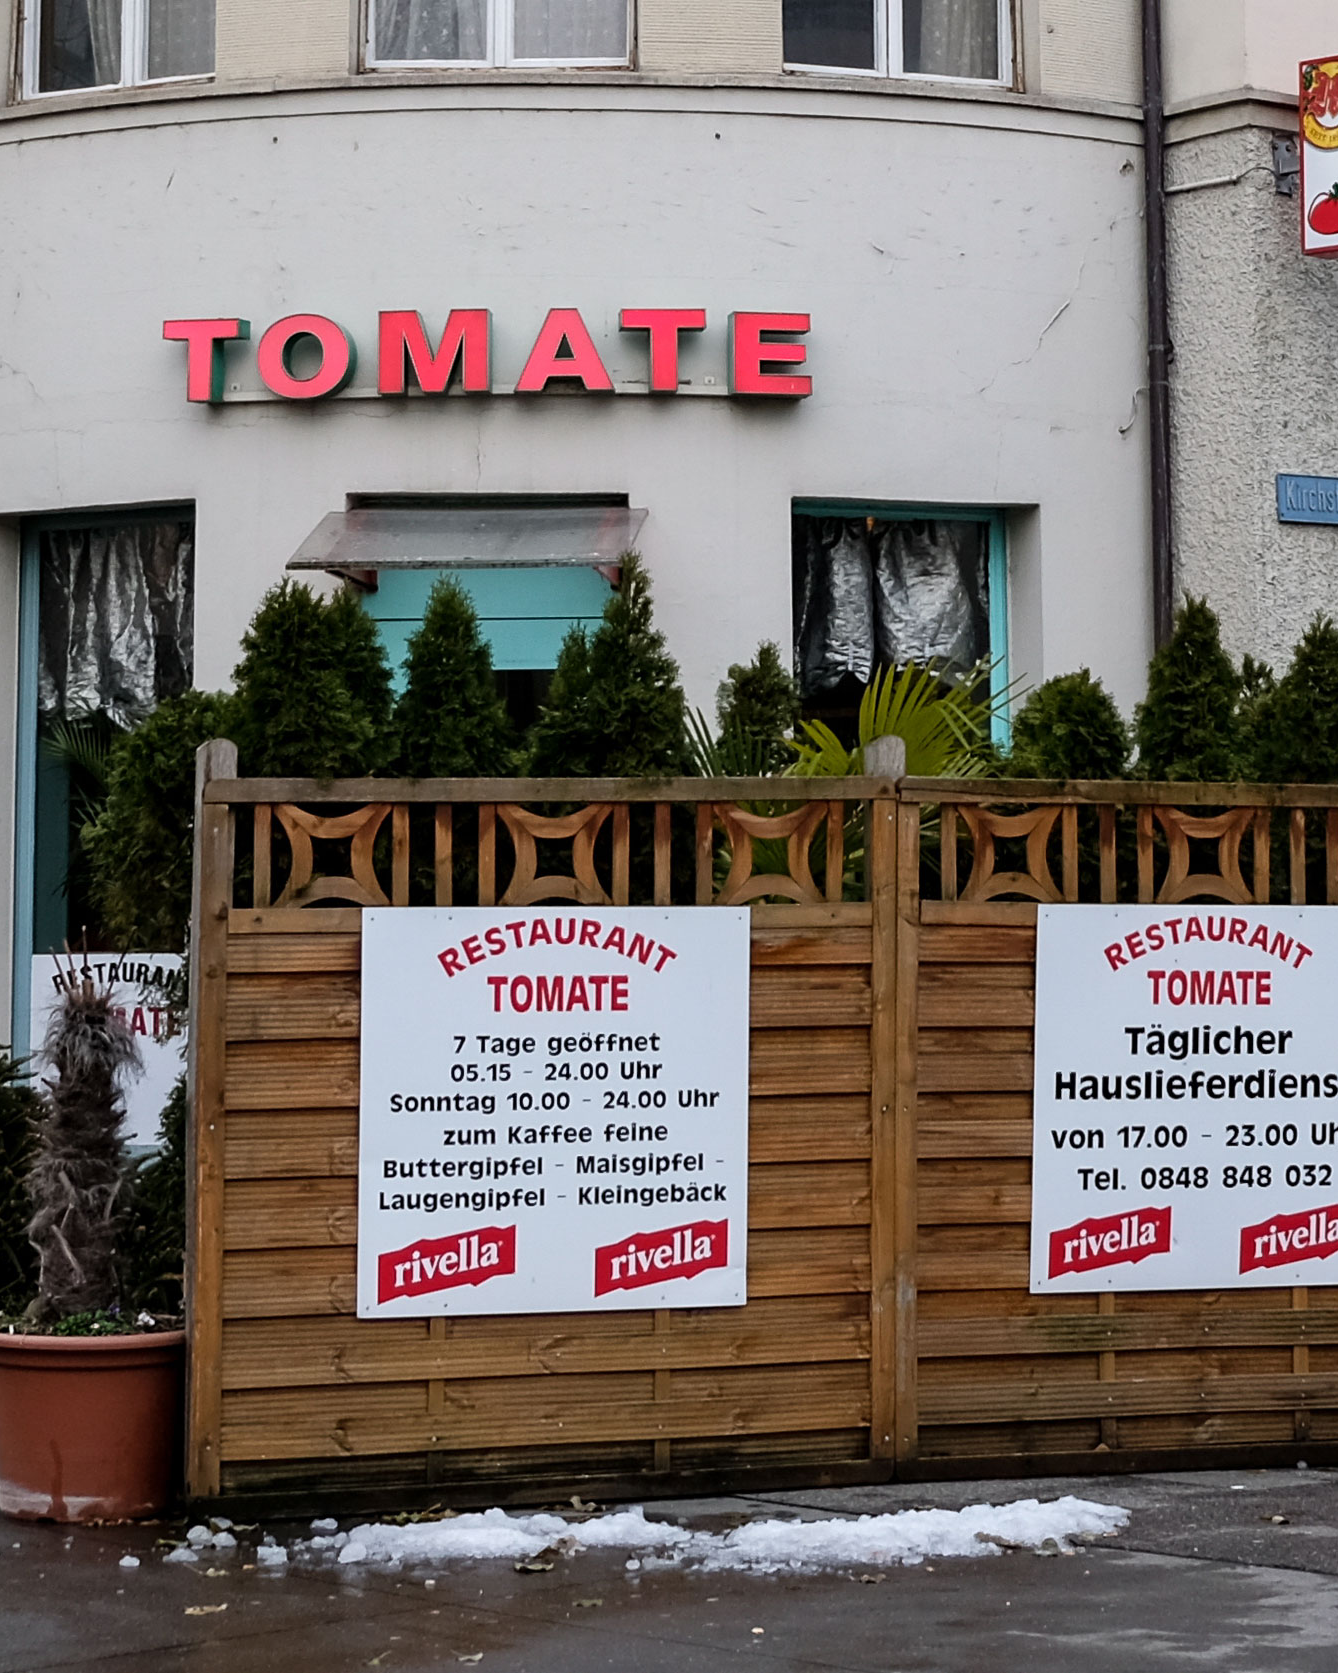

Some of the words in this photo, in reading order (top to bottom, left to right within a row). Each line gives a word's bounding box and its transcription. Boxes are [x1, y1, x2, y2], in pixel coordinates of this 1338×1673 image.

[162, 308, 813, 403] TOMATE
[437, 917, 678, 977] RESTAURANT
[1103, 916, 1313, 971] RESTAURANT
[487, 975, 629, 1012] TOMATE
[1147, 970, 1271, 1005] TOMATE
[453, 1035, 467, 1055] 7
[476, 1034, 536, 1056] Tage
[548, 1031, 661, 1056] geöffnet
[1125, 1024, 1293, 1060] Täglicher
[450, 1063, 512, 1082] 05.15
[544, 1063, 609, 1081] 24.00
[620, 1060, 663, 1080] Uhr
[390, 1092, 496, 1115] Sonntag
[506, 1092, 571, 1111] 10.00
[603, 1090, 666, 1109] 24.00
[678, 1088, 720, 1107] Uhr
[443, 1127, 497, 1146] zum
[507, 1124, 593, 1144] Kaffee
[604, 1122, 669, 1142] feine
[1051, 1128, 1104, 1149] von
[1117, 1126, 1188, 1148] 17.00
[1225, 1124, 1298, 1146] 23.00
[383, 1157, 543, 1180] Buttergipfel
[576, 1152, 704, 1176] Maisgipfel
[1078, 1167, 1127, 1190] Tel.
[1141, 1166, 1209, 1189] 0848
[1222, 1165, 1272, 1188] 848
[1285, 1164, 1333, 1187] 032
[379, 1187, 545, 1212] Laugengipfel
[577, 1182, 727, 1208] Kleingebäck
[610, 1229, 712, 1281] rivella
[1063, 1216, 1157, 1264] rivella
[394, 1234, 499, 1287] rivella
